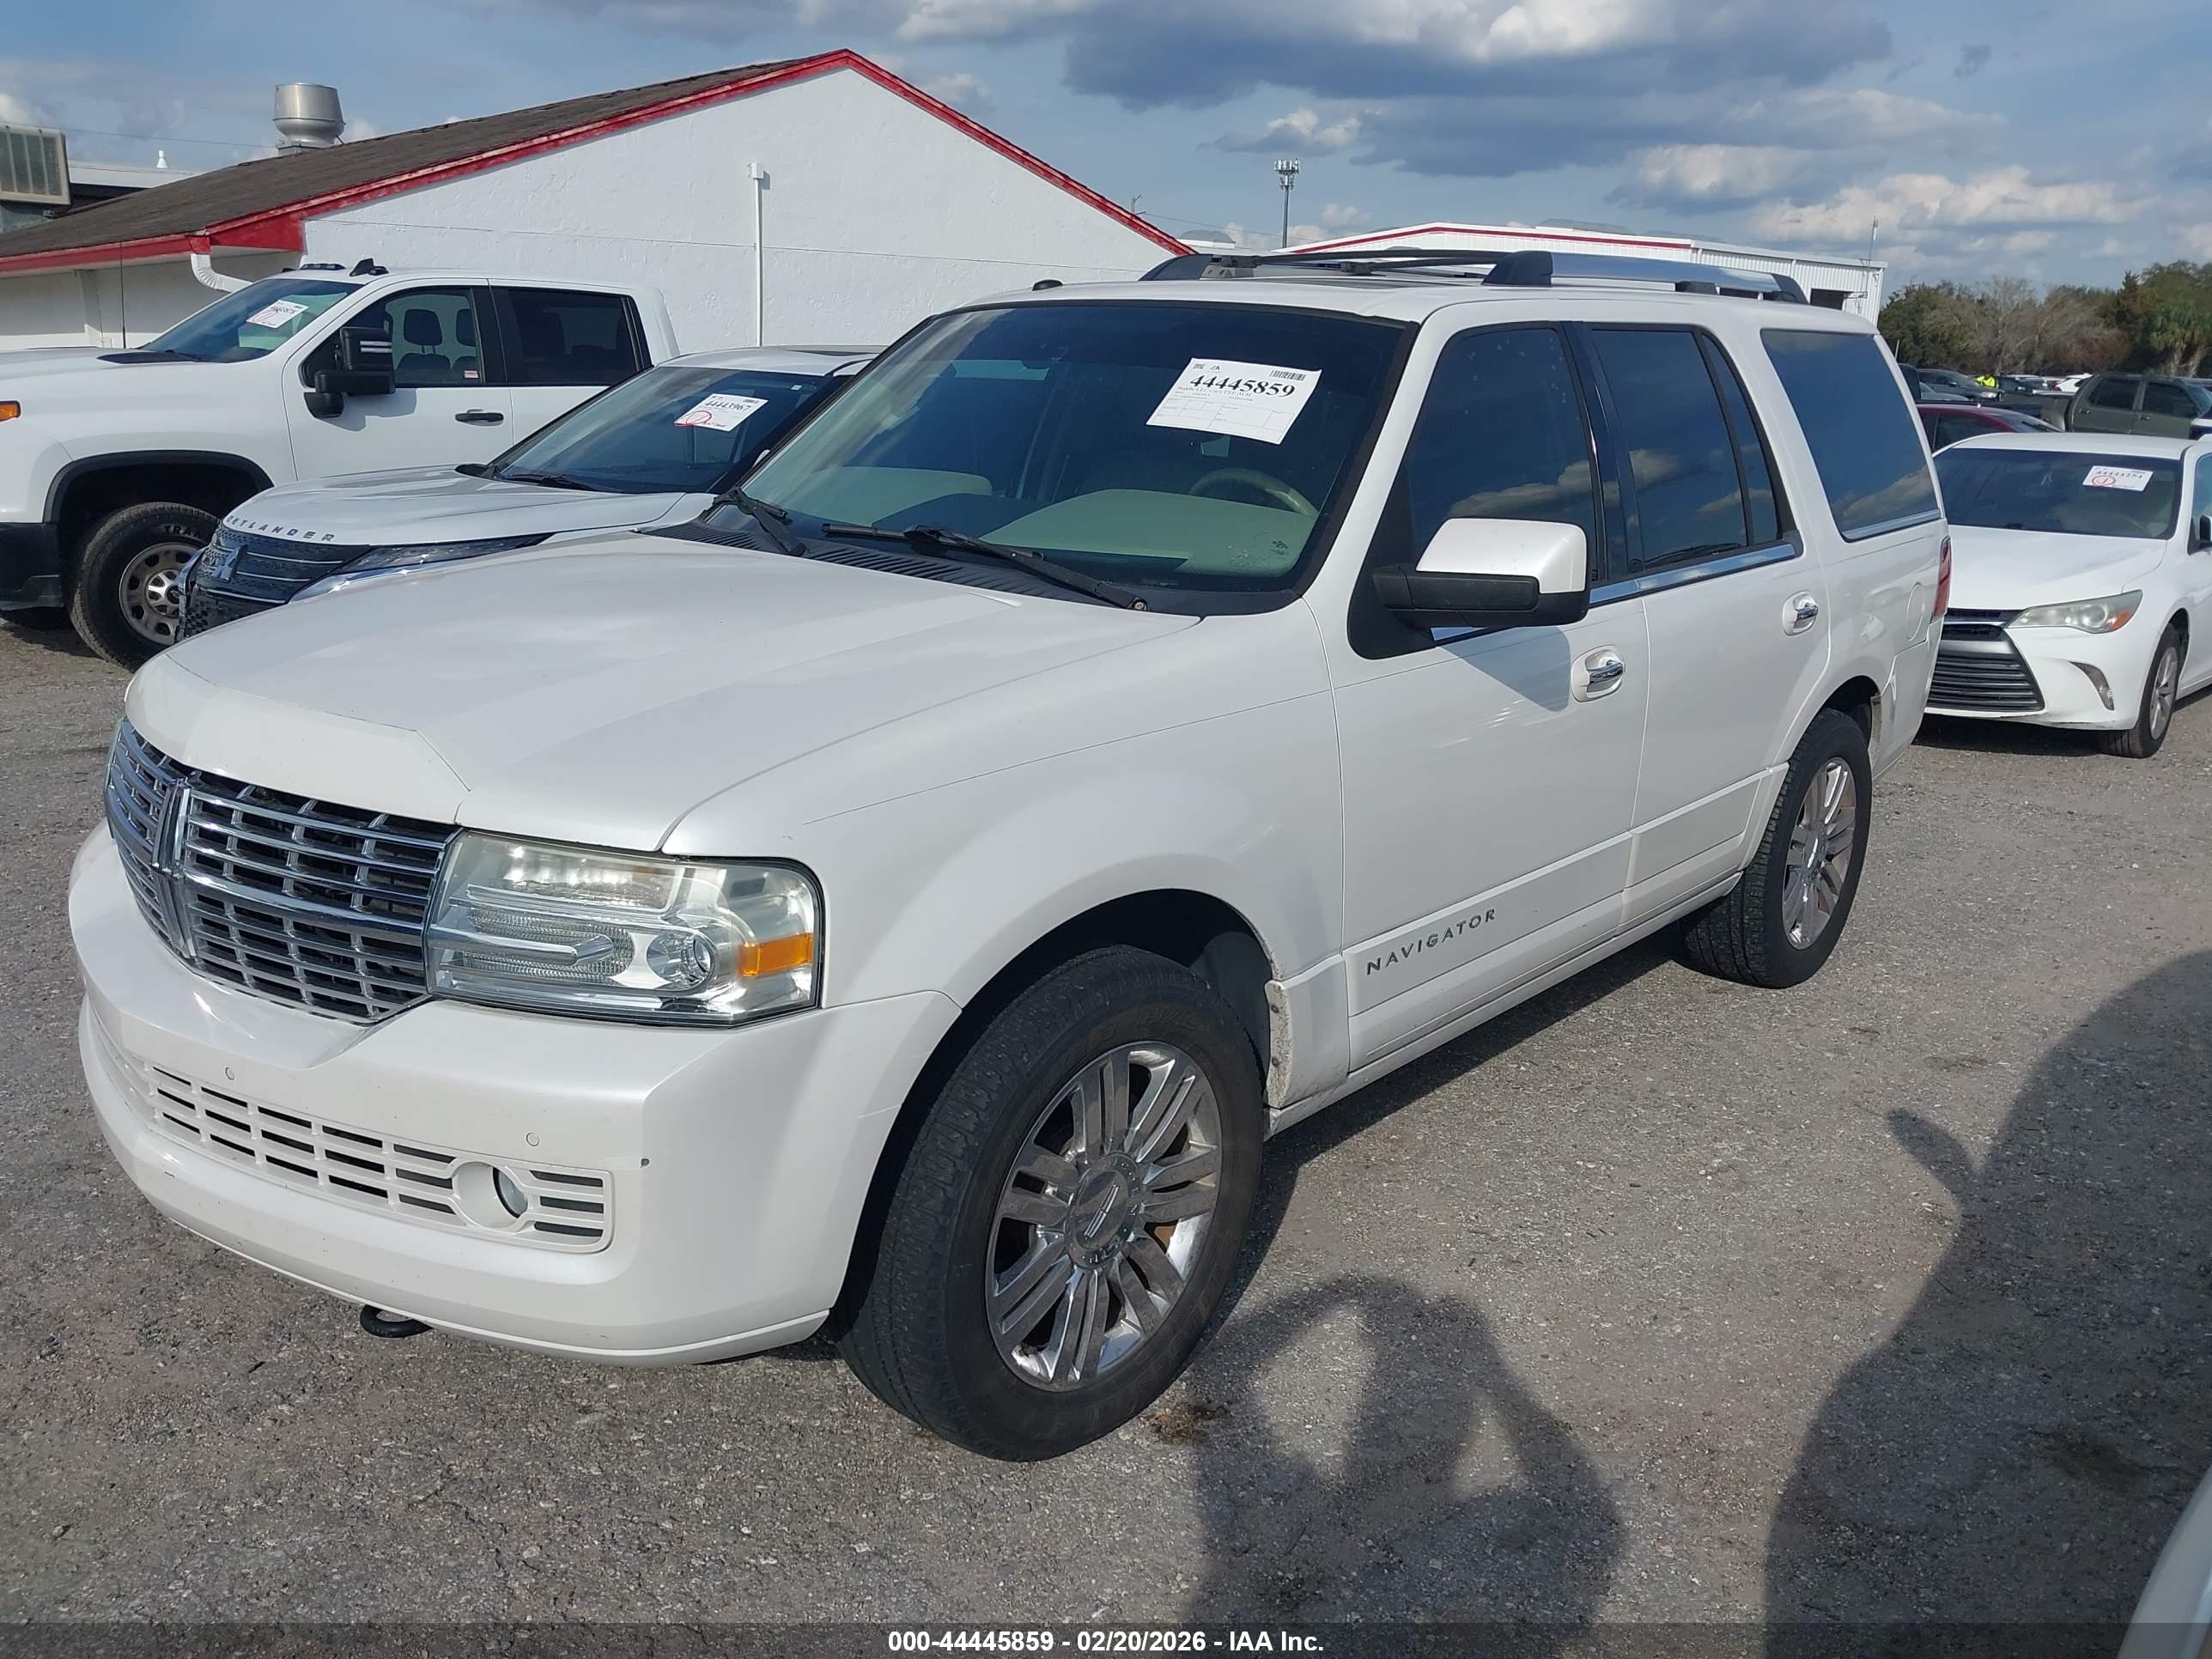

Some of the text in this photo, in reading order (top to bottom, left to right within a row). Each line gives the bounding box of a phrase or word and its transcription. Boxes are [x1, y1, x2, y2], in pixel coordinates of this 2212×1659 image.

[1190, 374, 1296, 398] 44445859
[226, 515, 336, 542] OUTLANDER
[1365, 908, 1496, 976] NAVIGATOR
